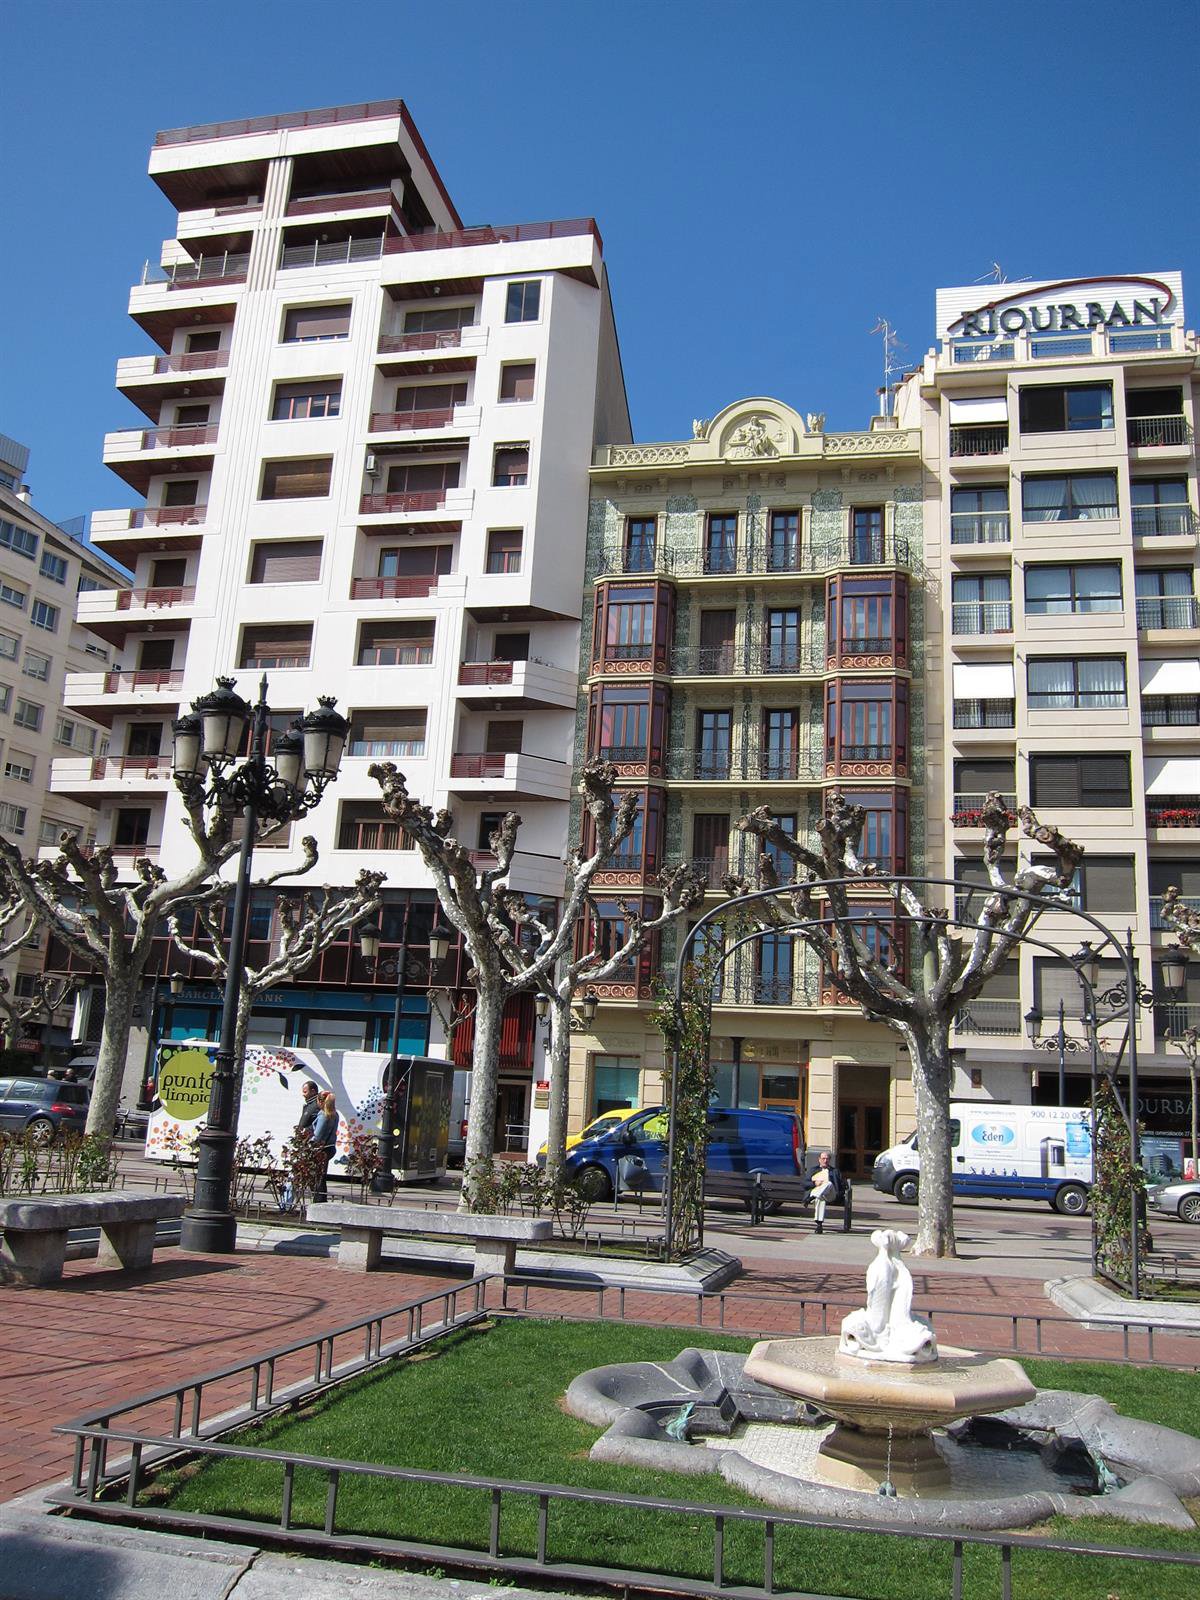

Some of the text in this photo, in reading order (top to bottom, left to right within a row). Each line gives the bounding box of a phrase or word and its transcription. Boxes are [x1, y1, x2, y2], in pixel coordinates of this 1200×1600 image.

[961, 297, 1159, 336] RIOURBAN
[254, 993, 284, 1003] ANK
[1031, 1110, 1046, 1119] 900
[1049, 1111, 1058, 1119] 12
[1060, 1111, 1070, 1119] 20
[982, 1131, 1004, 1142] Eden
